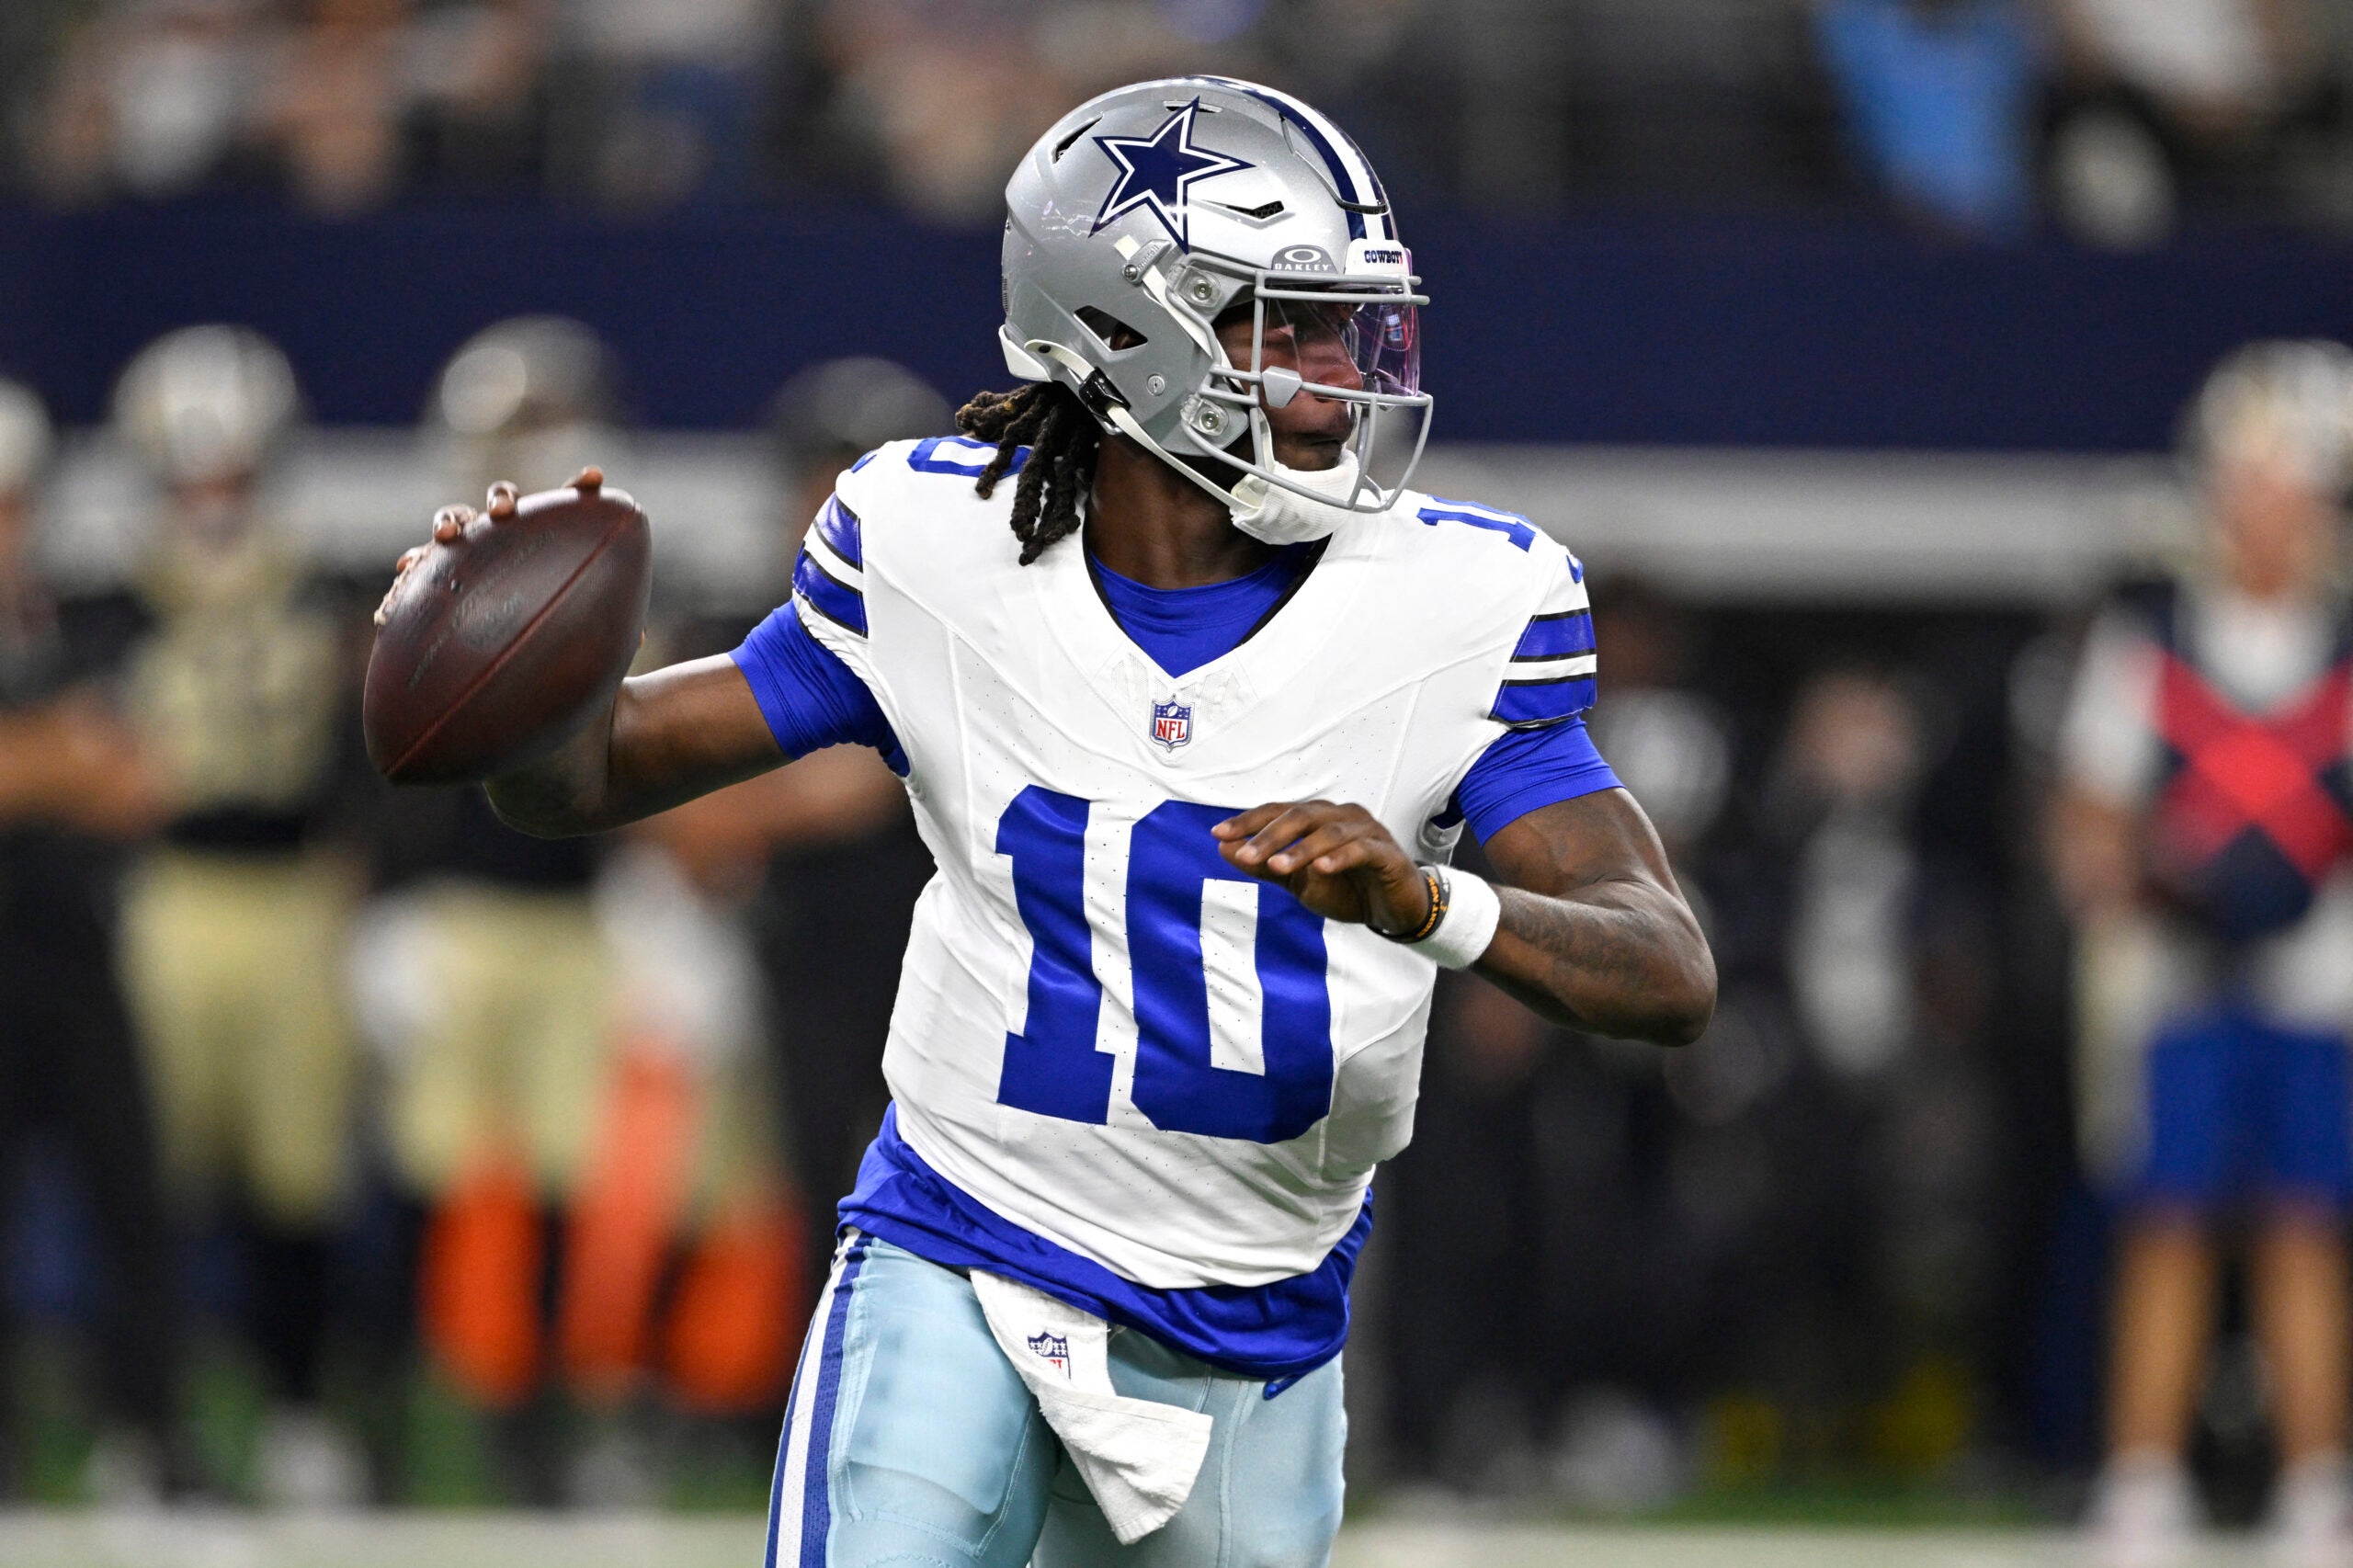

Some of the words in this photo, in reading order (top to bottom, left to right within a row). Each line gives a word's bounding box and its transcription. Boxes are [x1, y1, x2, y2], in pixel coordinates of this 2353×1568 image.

[1273, 263, 1329, 271] OAKLEY
[1155, 719, 1186, 741] NFL
[995, 783, 1335, 1145] 10
